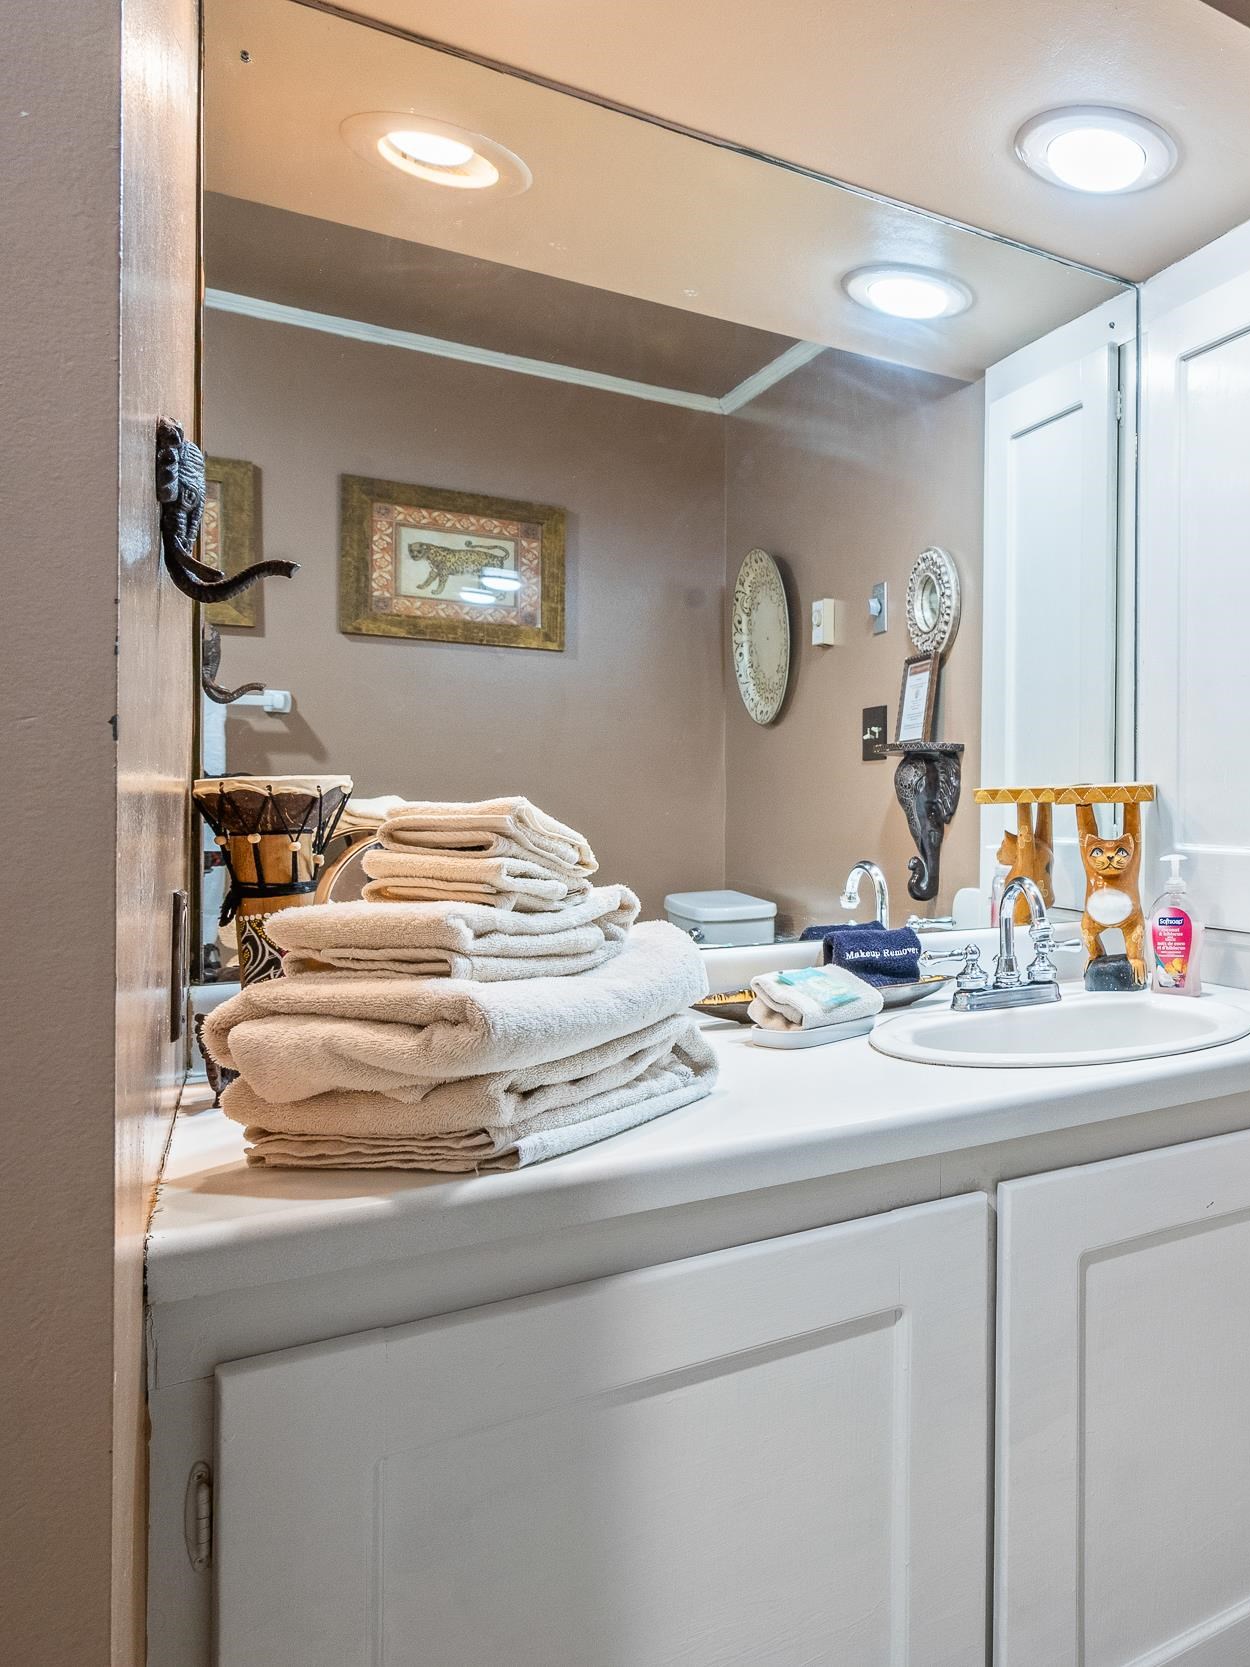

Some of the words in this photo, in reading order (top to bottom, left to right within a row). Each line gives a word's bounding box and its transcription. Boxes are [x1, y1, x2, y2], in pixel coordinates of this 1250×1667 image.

[1160, 918, 1184, 926] Softsoap
[845, 950, 880, 960] Makeup
[883, 947, 919, 958] Remover
